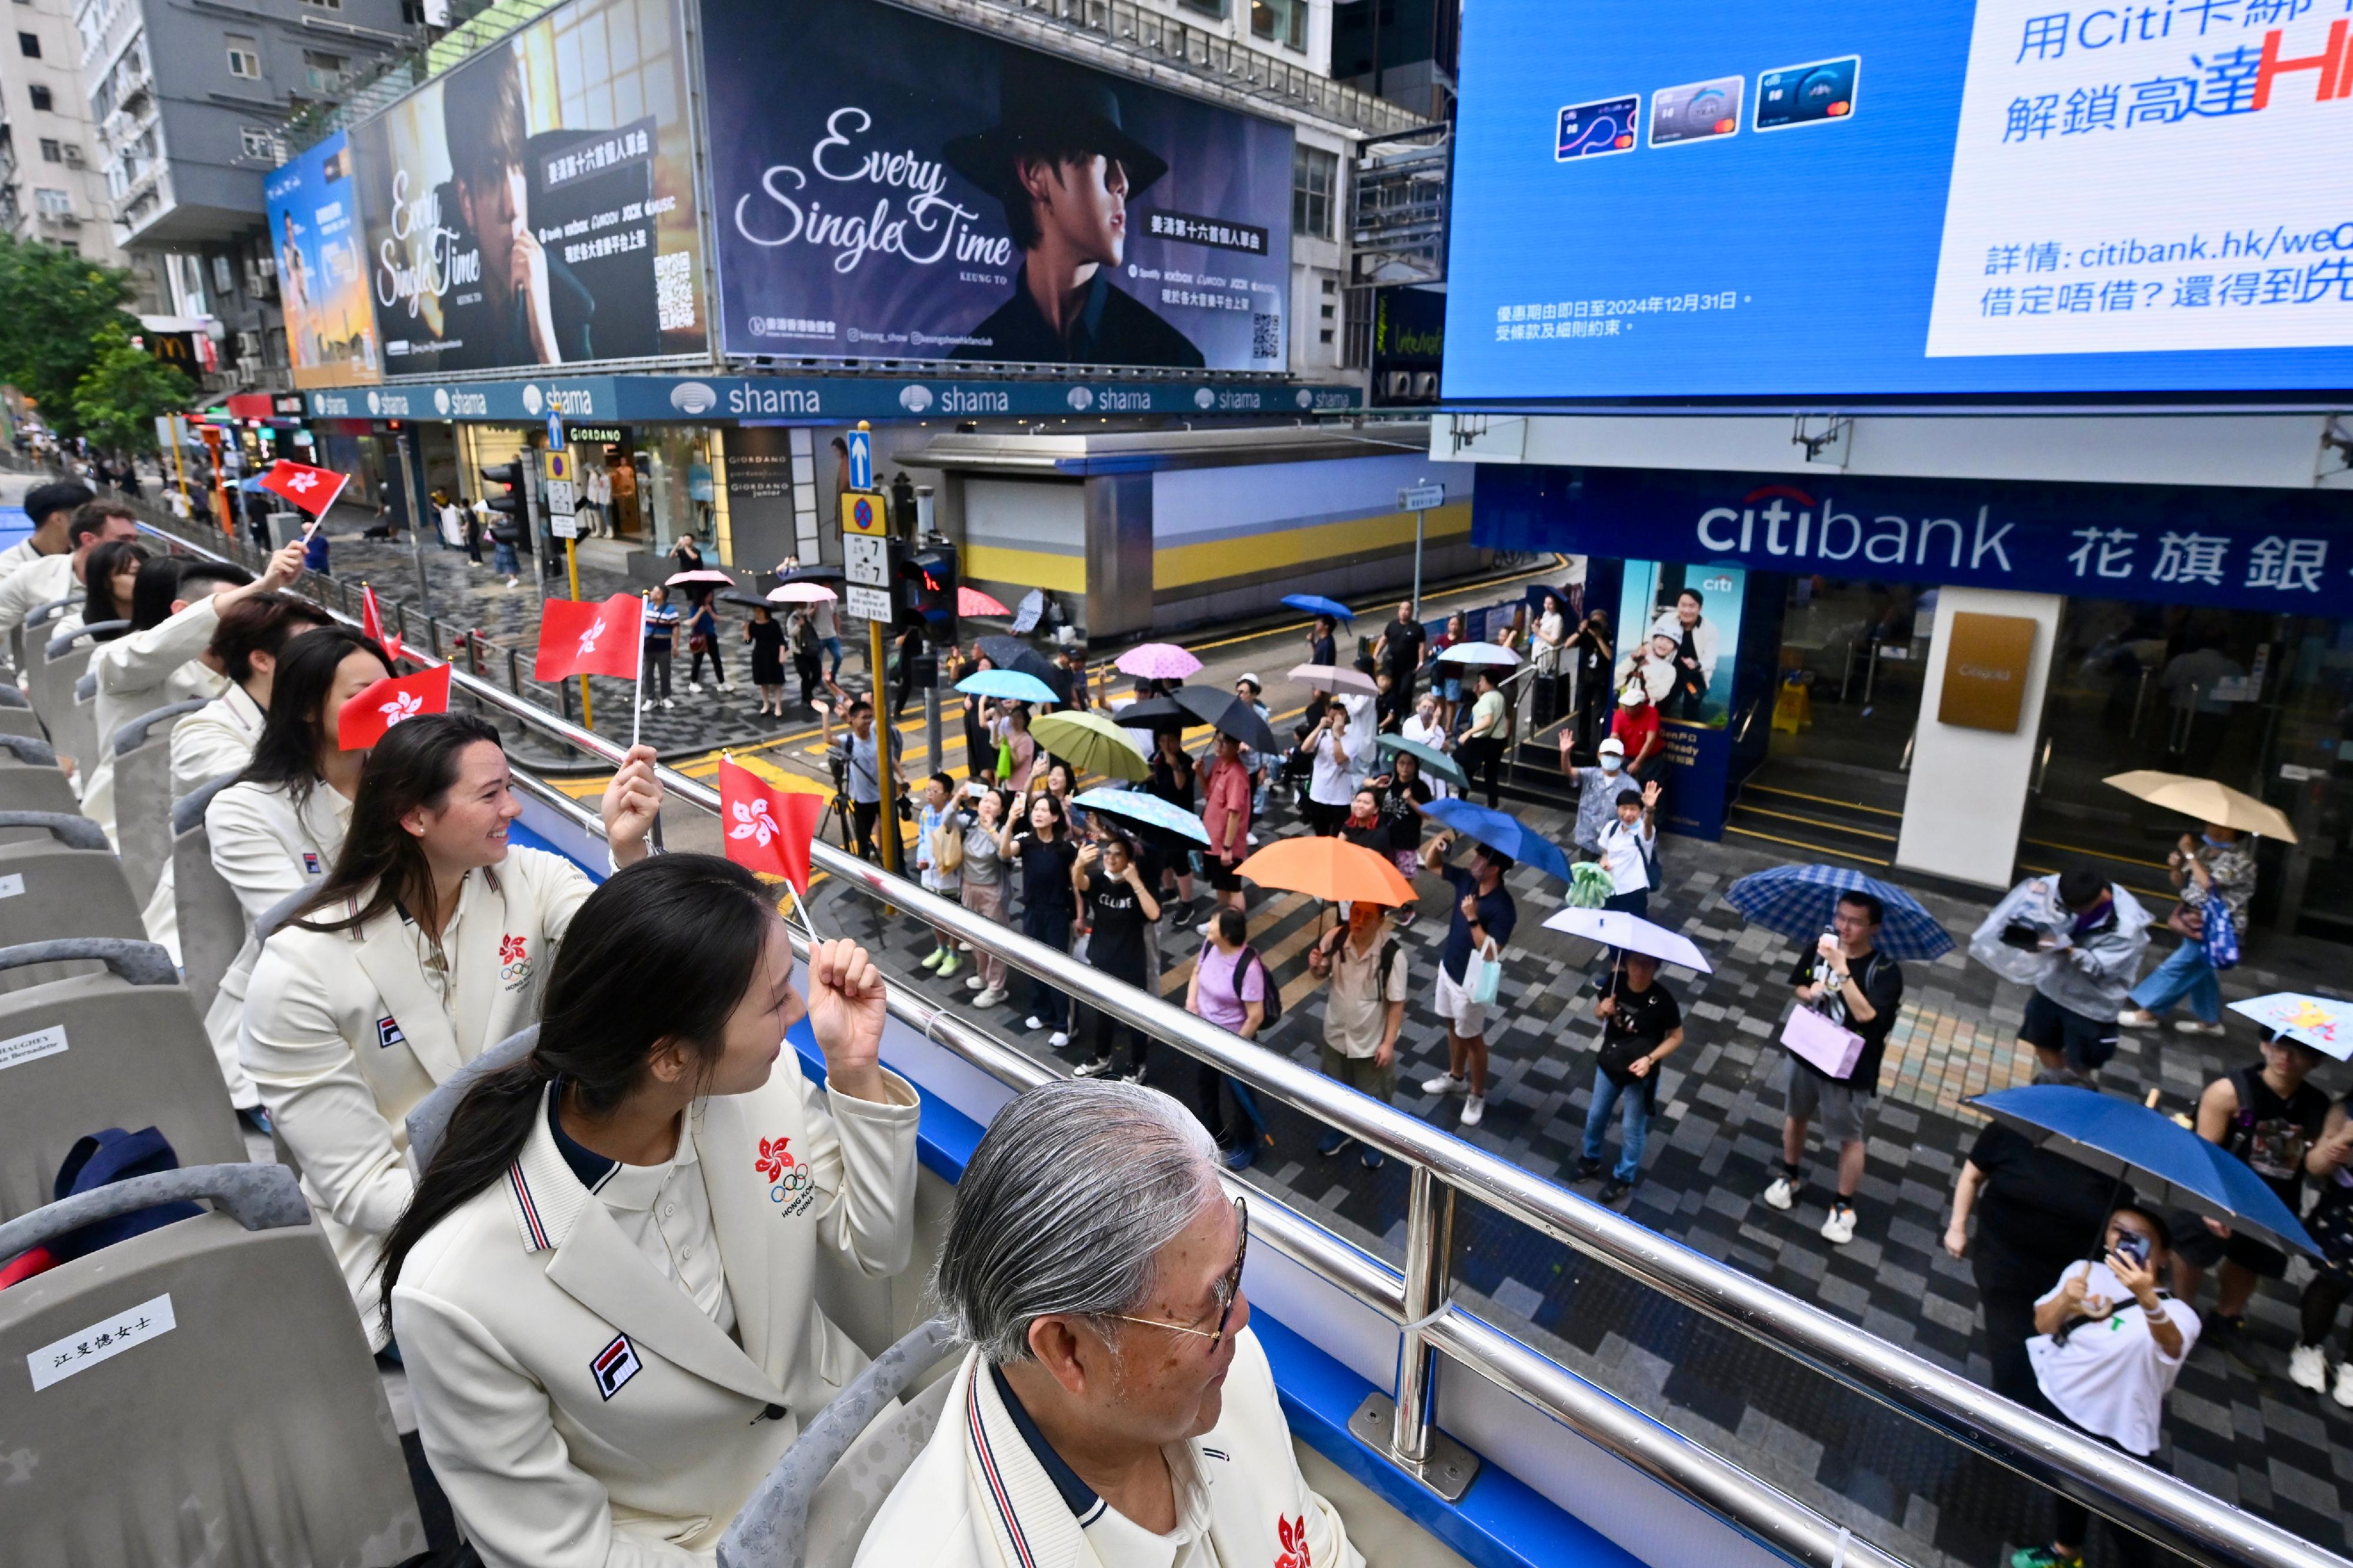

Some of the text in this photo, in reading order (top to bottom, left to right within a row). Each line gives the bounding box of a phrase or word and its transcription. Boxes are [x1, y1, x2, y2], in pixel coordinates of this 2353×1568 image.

[2251, 19, 2353, 110] H
[812, 107, 946, 194] Every
[392, 169, 442, 240] Every
[735, 165, 1012, 273] Single Time
[1985, 240, 2072, 275] 詳情:
[377, 239, 432, 318] Single
[429, 226, 481, 296] Time
[381, 391, 409, 415] shama
[451, 388, 487, 415] shama
[729, 382, 821, 413] shama
[941, 385, 1008, 412] shama
[1098, 386, 1151, 410] shama
[1219, 387, 1261, 410] shama
[1315, 388, 1350, 408] shama
[570, 427, 622, 442] GIORDANO
[728, 455, 787, 464] GIORDANO
[731, 482, 789, 492] GIORDANO
[871, 540, 878, 556] 7
[1697, 498, 2015, 572] citibank
[2068, 526, 2353, 593] 花旗銀
[873, 566, 880, 582] 7
[1704, 578, 1732, 592] citi
[11, 1042, 58, 1059] Bernadette
[781, 1179, 815, 1219] HONG KONG
[796, 1196, 814, 1217] CHINA
[54, 1317, 151, 1367] 江旻憓女士
